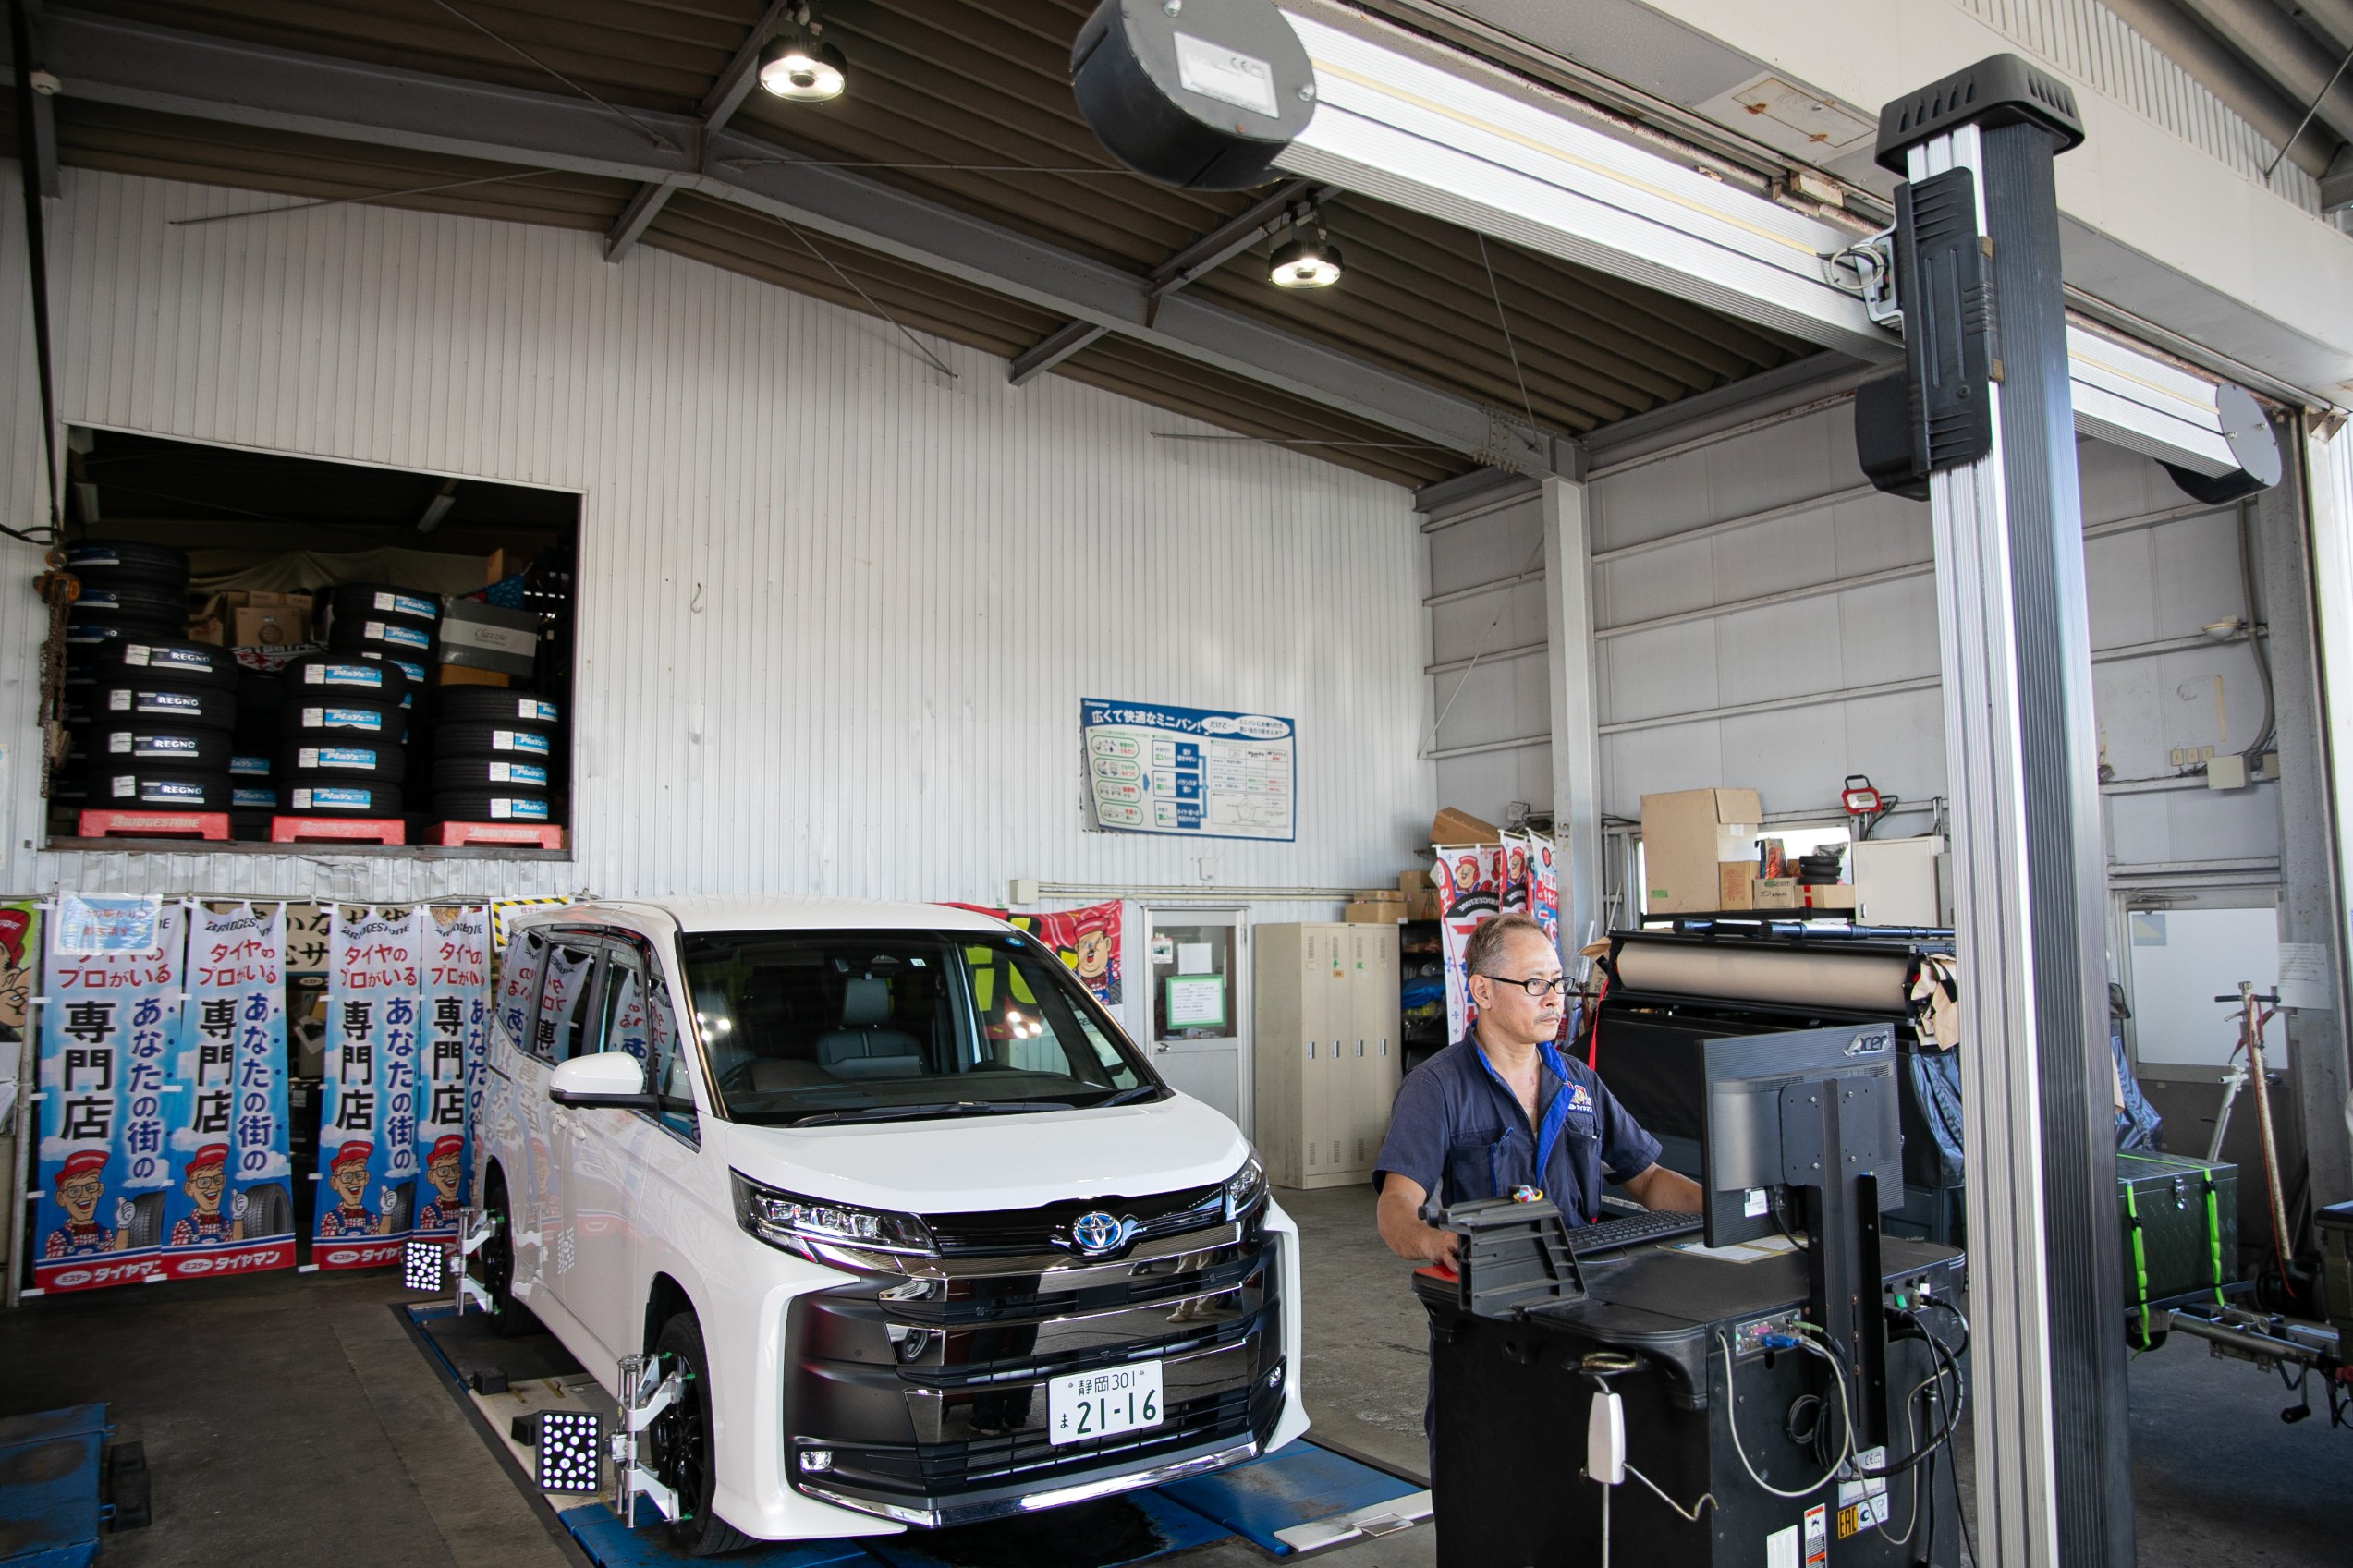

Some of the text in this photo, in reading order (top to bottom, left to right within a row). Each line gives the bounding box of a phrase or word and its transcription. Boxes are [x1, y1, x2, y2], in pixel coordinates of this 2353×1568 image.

[171, 652, 211, 662] REGNO
[157, 696, 199, 706] REGNO
[154, 740, 196, 748] REGNO
[162, 785, 202, 795] REGNO
[110, 814, 201, 828] BRIDGESTONE
[211, 939, 276, 963] タイヤの
[345, 943, 408, 966] タイヤの
[58, 964, 172, 989] プロがいる
[199, 965, 278, 987] プロがいる
[340, 966, 418, 989] プロがいる
[60, 1000, 116, 1141] 専門店
[192, 998, 239, 1134] 専門店
[335, 1000, 374, 1131] 専門店
[430, 995, 465, 1125] 専門店
[127, 997, 164, 1179] あなたの街の
[238, 992, 273, 1172] あなたの街の
[386, 996, 415, 1170] あなたの街の
[184, 1251, 281, 1270] ミスター タイヤマン
[1079, 1371, 1135, 1396] 静岡 301
[1060, 1389, 1157, 1435] ま 21-16
[1839, 1506, 1857, 1538] EAC
